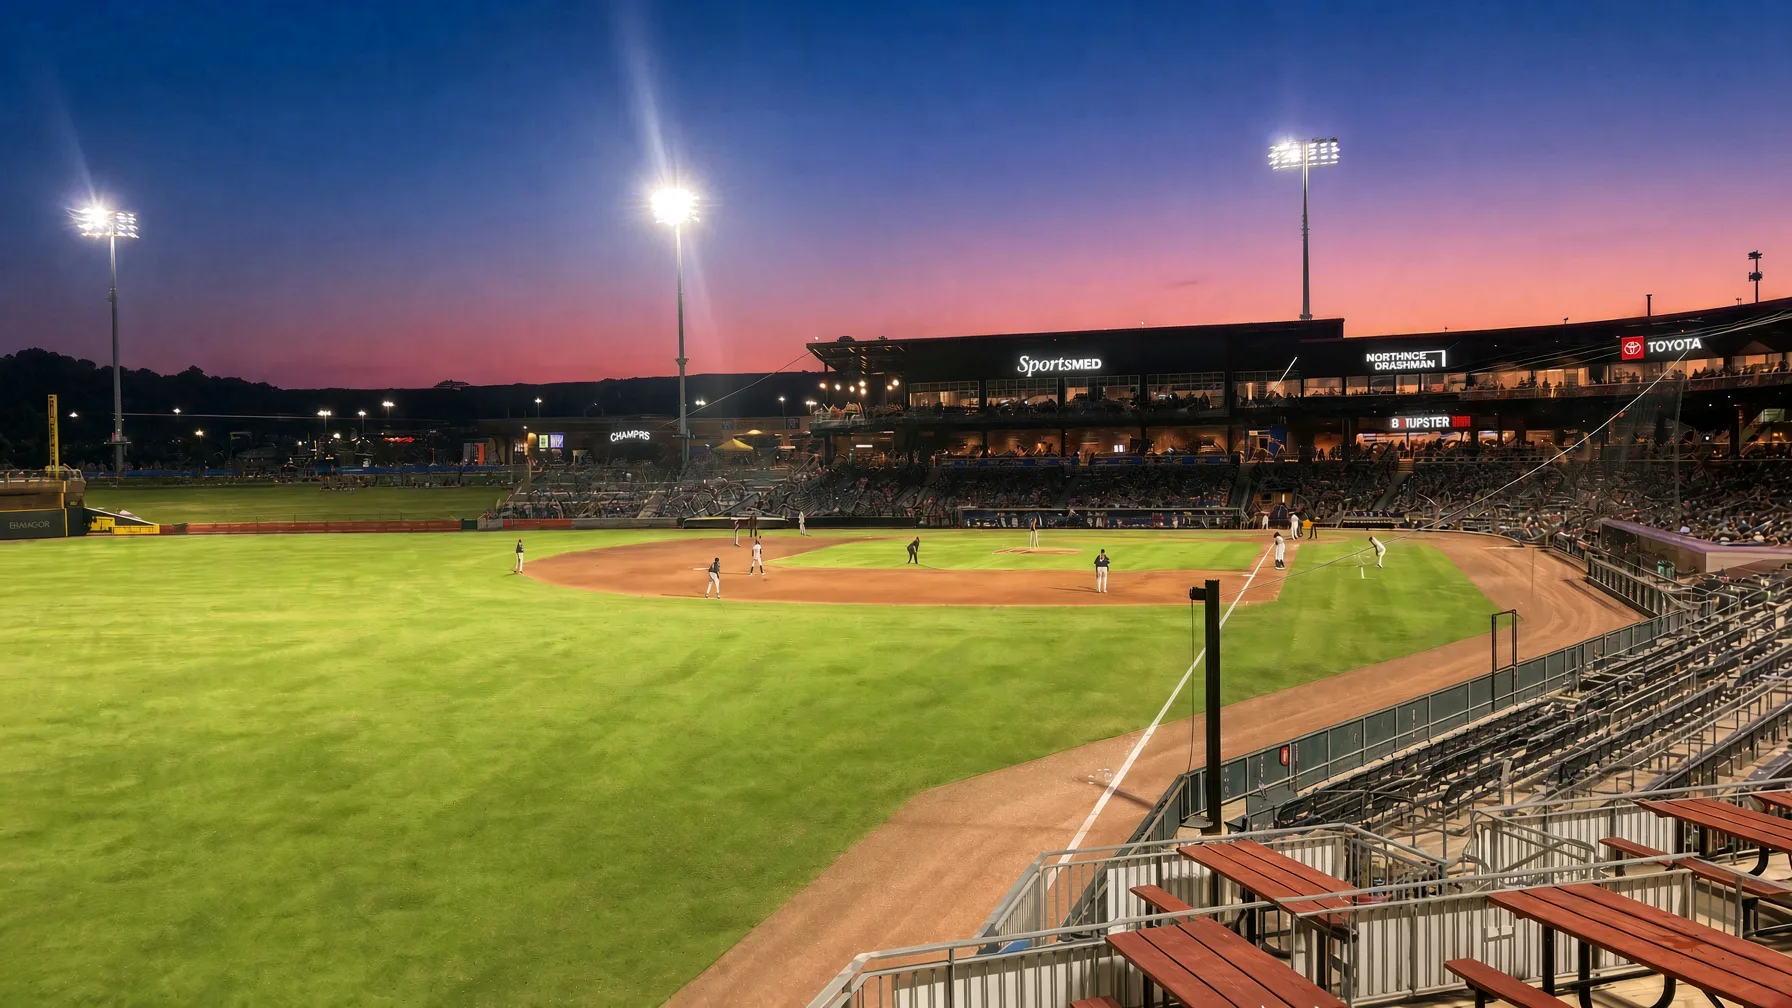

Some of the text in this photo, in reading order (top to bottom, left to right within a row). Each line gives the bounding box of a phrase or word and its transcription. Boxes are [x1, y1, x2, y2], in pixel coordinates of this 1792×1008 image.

[1647, 338, 1702, 353] TOYOTA
[1366, 352, 1427, 362] NORTHNCE
[1017, 355, 1102, 377] SportsMED
[610, 430, 651, 442] CHAMPRS
